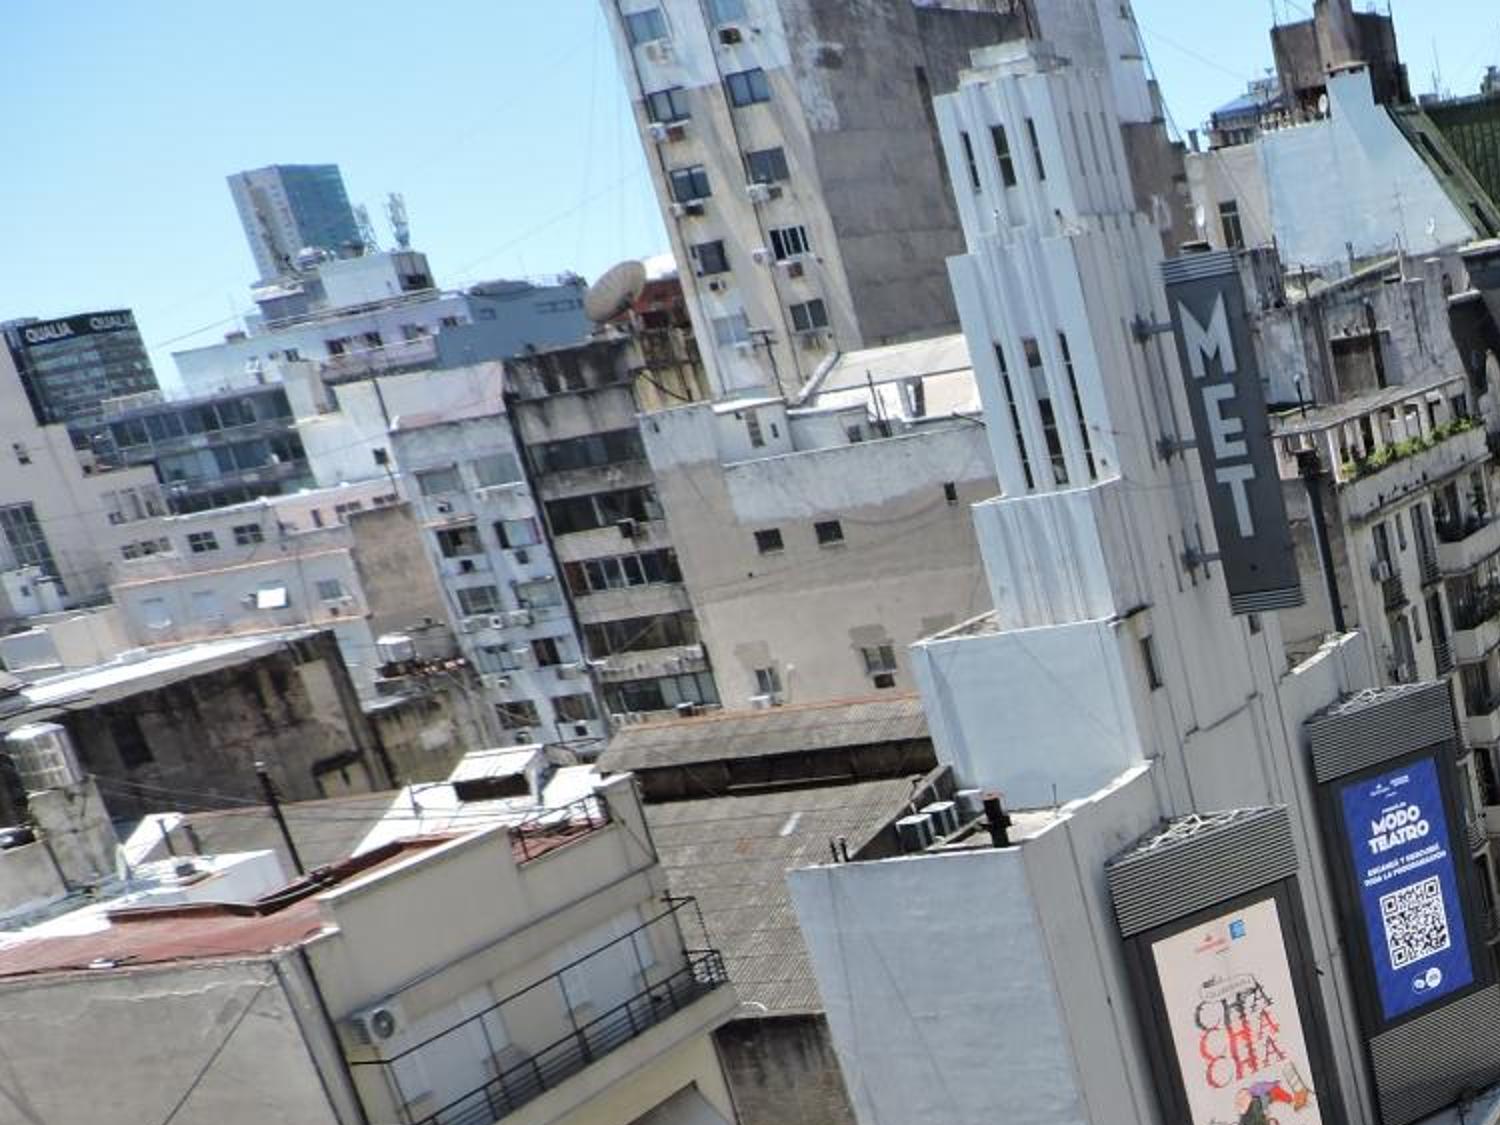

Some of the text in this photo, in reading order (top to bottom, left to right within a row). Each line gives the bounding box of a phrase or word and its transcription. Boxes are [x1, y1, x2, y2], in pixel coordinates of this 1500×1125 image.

[25, 322, 74, 343] QUALIA
[1177, 291, 1255, 537] MET
[1368, 820, 1429, 854] TEATRO
[1371, 805, 1420, 835] MODO
[1206, 1035, 1286, 1088] CHA
